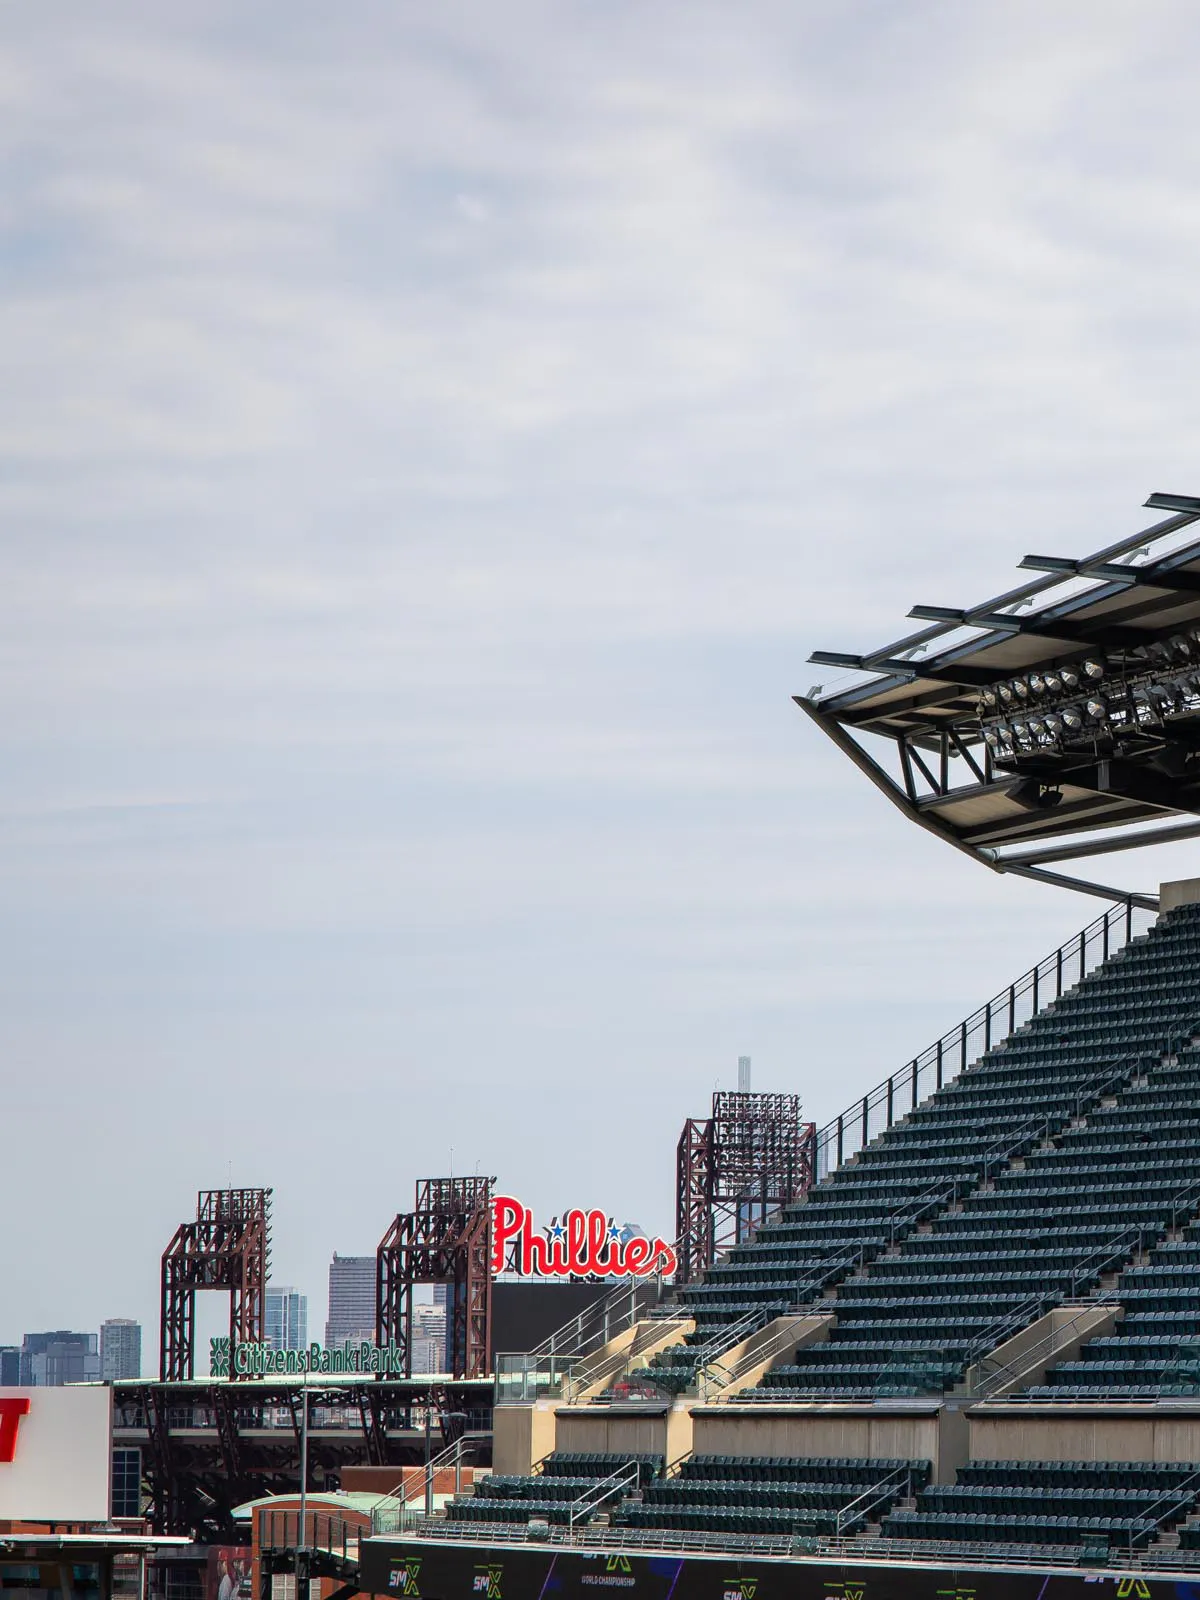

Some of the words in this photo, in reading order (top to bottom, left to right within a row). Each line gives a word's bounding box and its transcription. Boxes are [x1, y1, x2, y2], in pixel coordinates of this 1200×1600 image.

[490, 1195, 678, 1277] Phillies
[234, 1341, 306, 1375] Citizens
[309, 1339, 357, 1373] Bank
[359, 1337, 403, 1373] Park
[389, 1565, 420, 1595] SMX
[473, 1571, 502, 1599] SMX
[599, 1577, 636, 1587] CHAMPIONSHIP
